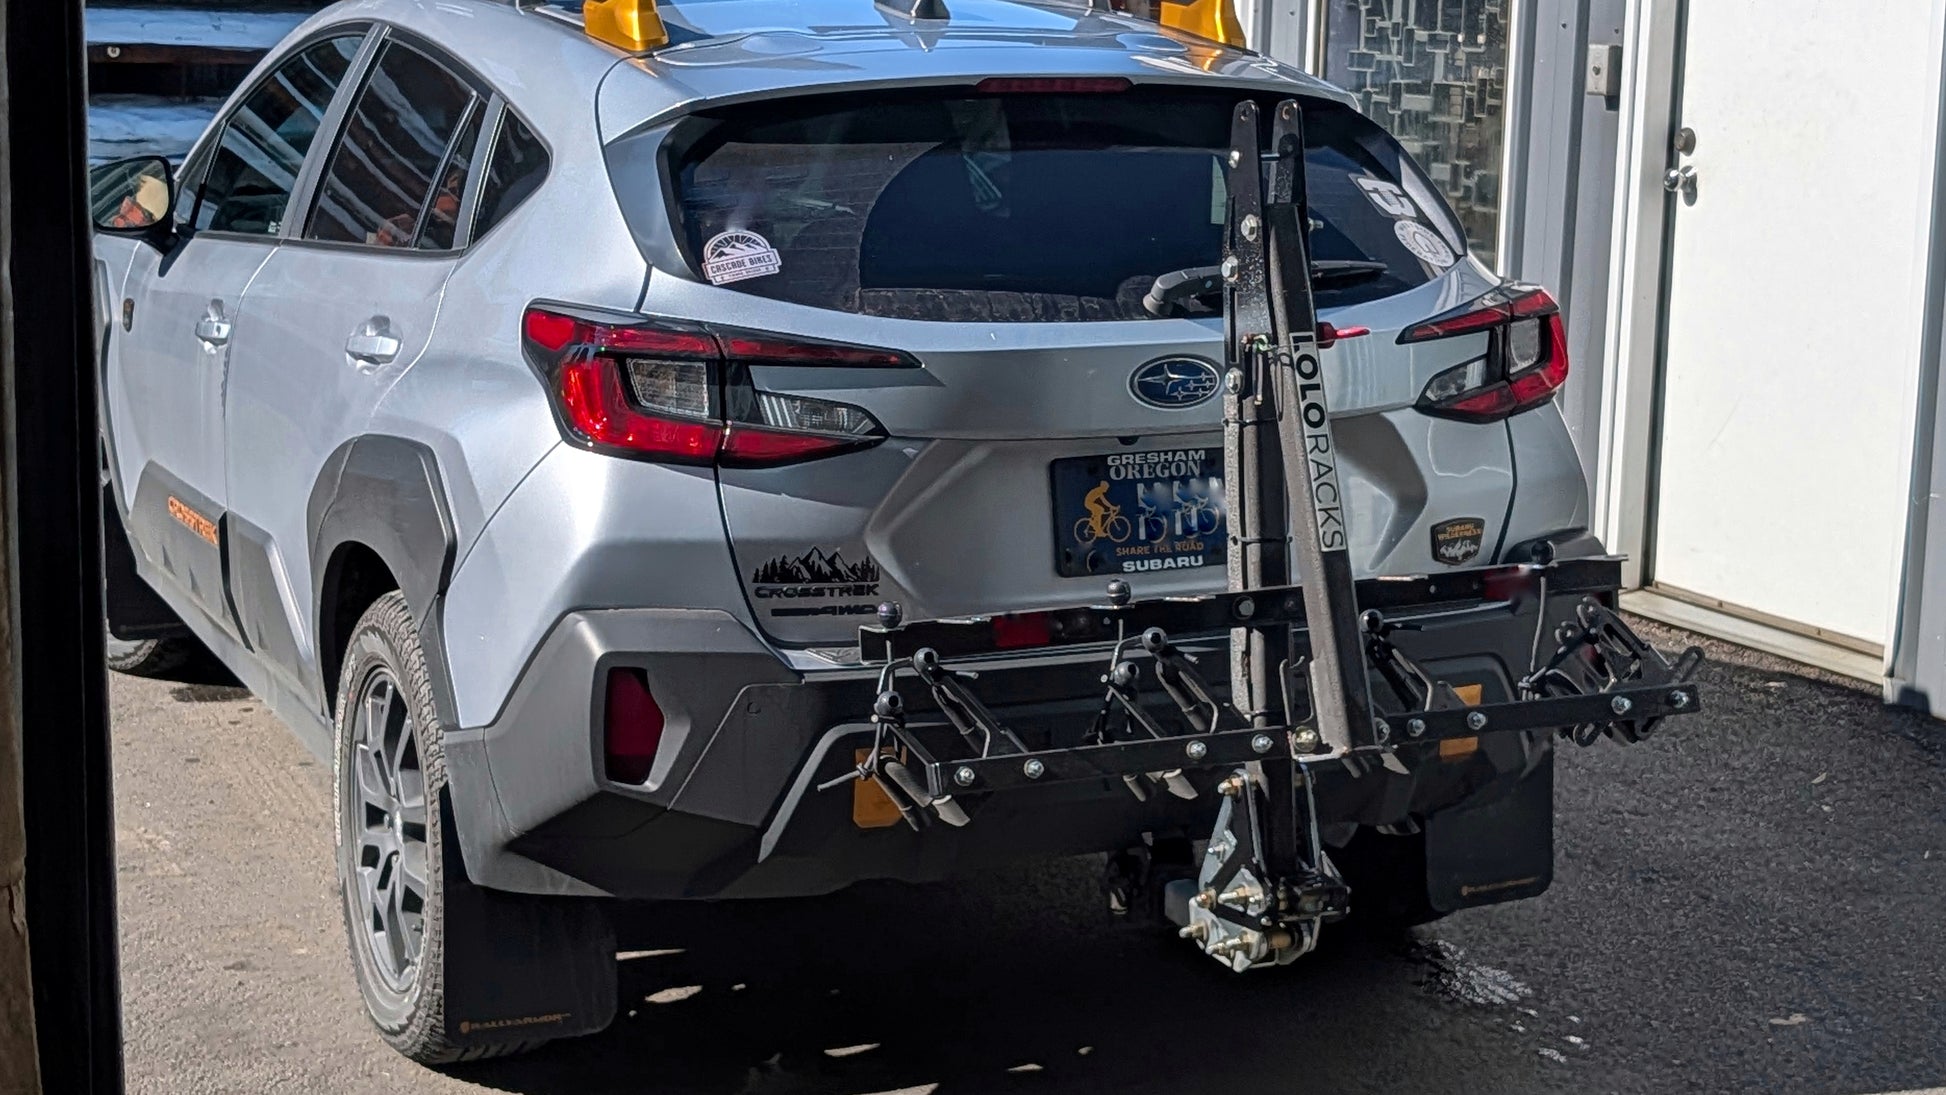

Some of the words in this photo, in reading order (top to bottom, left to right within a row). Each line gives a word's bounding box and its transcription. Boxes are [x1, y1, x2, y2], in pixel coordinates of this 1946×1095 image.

[710, 259, 746, 275] CASCADE
[749, 253, 774, 266] BIKES
[1107, 450, 1206, 466] GRESHAM
[1109, 460, 1201, 480] OREGON
[1116, 545, 1151, 556] SHARE
[1175, 541, 1204, 551] ROAD
[1122, 555, 1204, 572] SUBARU
[754, 583, 880, 598] CROSSTREK
